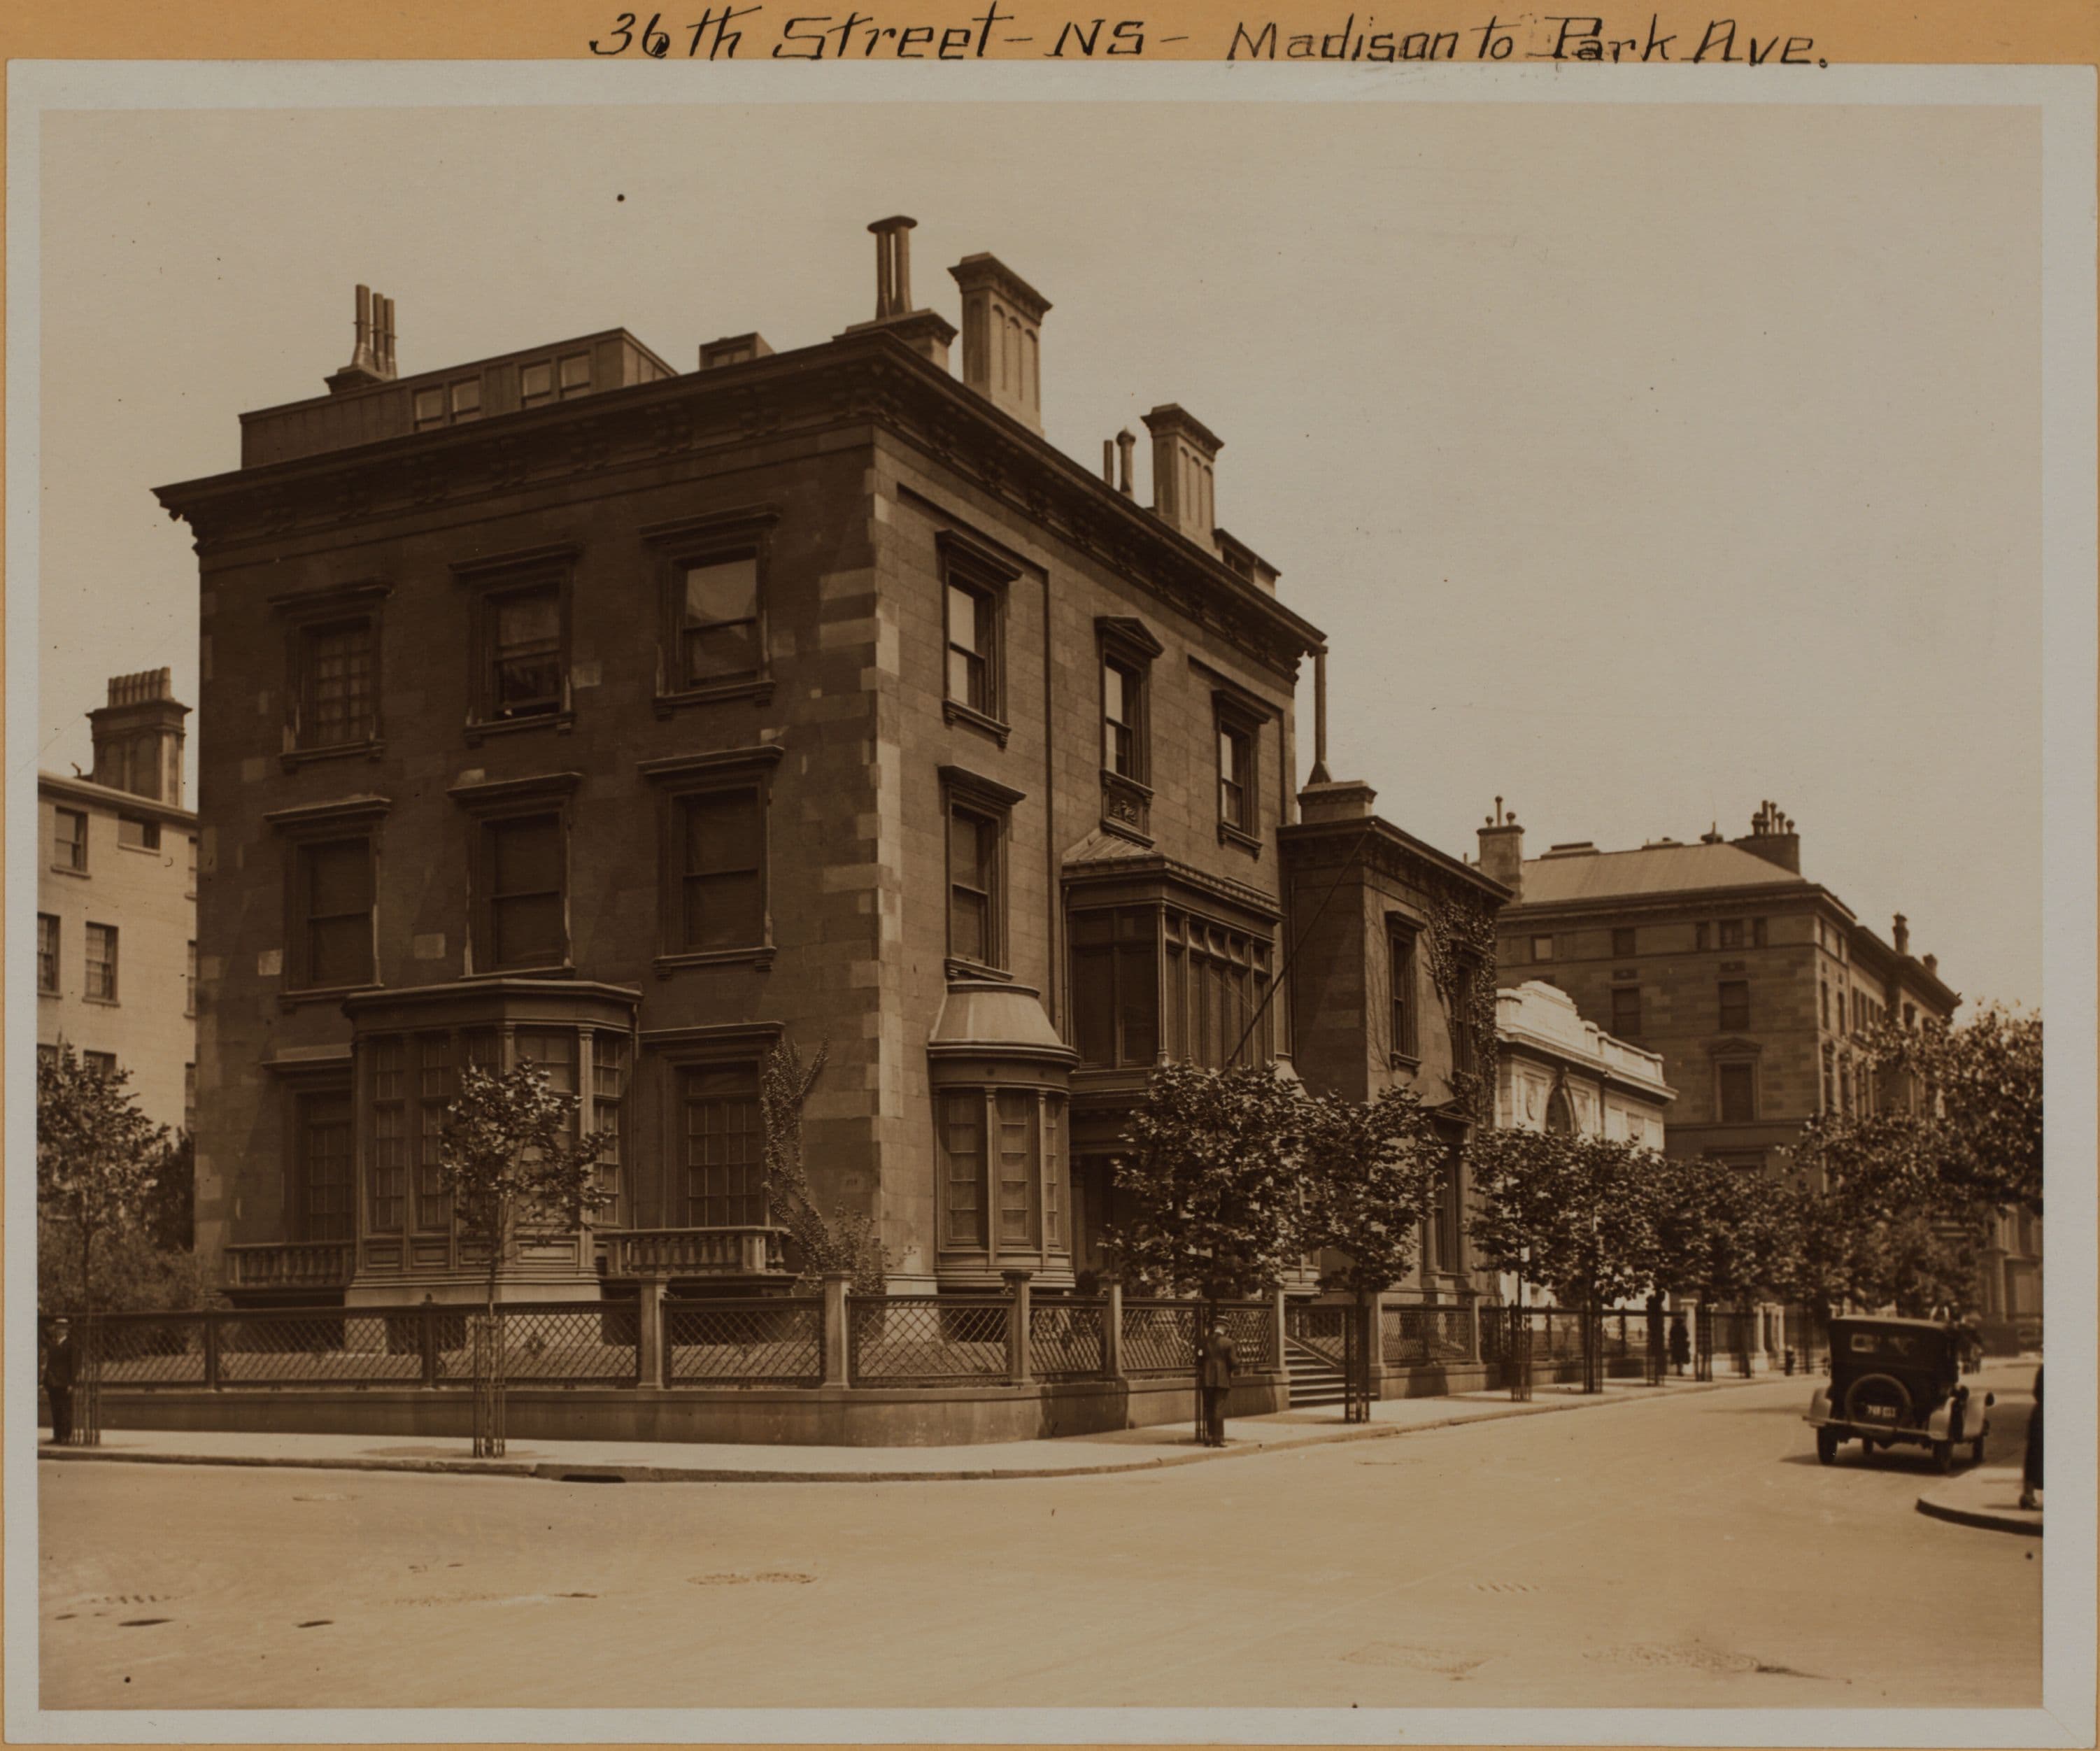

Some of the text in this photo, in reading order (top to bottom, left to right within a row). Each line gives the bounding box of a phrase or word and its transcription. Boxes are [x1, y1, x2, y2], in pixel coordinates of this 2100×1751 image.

[589, 6, 762, 61] 36th
[1227, 14, 1459, 62] Madison
[1470, 16, 1521, 60] to
[1543, 14, 1677, 64] Park
[1680, 20, 1828, 68] Ave.
